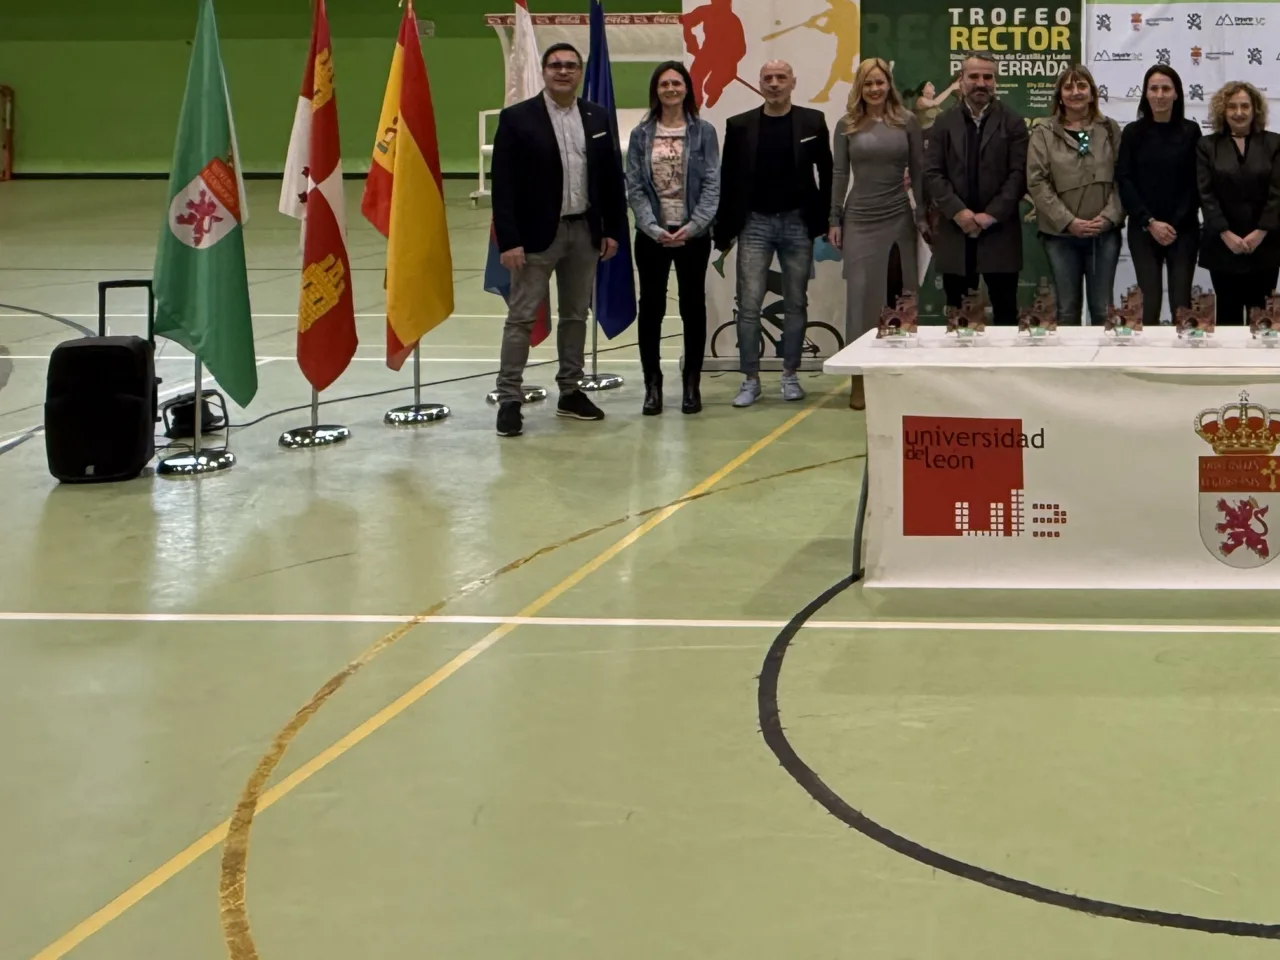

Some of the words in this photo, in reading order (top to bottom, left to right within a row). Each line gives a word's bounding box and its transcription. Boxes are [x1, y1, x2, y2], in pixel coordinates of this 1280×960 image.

[948, 7, 1071, 26] TROFEO
[950, 26, 1071, 51] RECTOR
[950, 60, 1068, 76] PERRADA
[905, 426, 1045, 449] universidad
[925, 446, 974, 469] león
